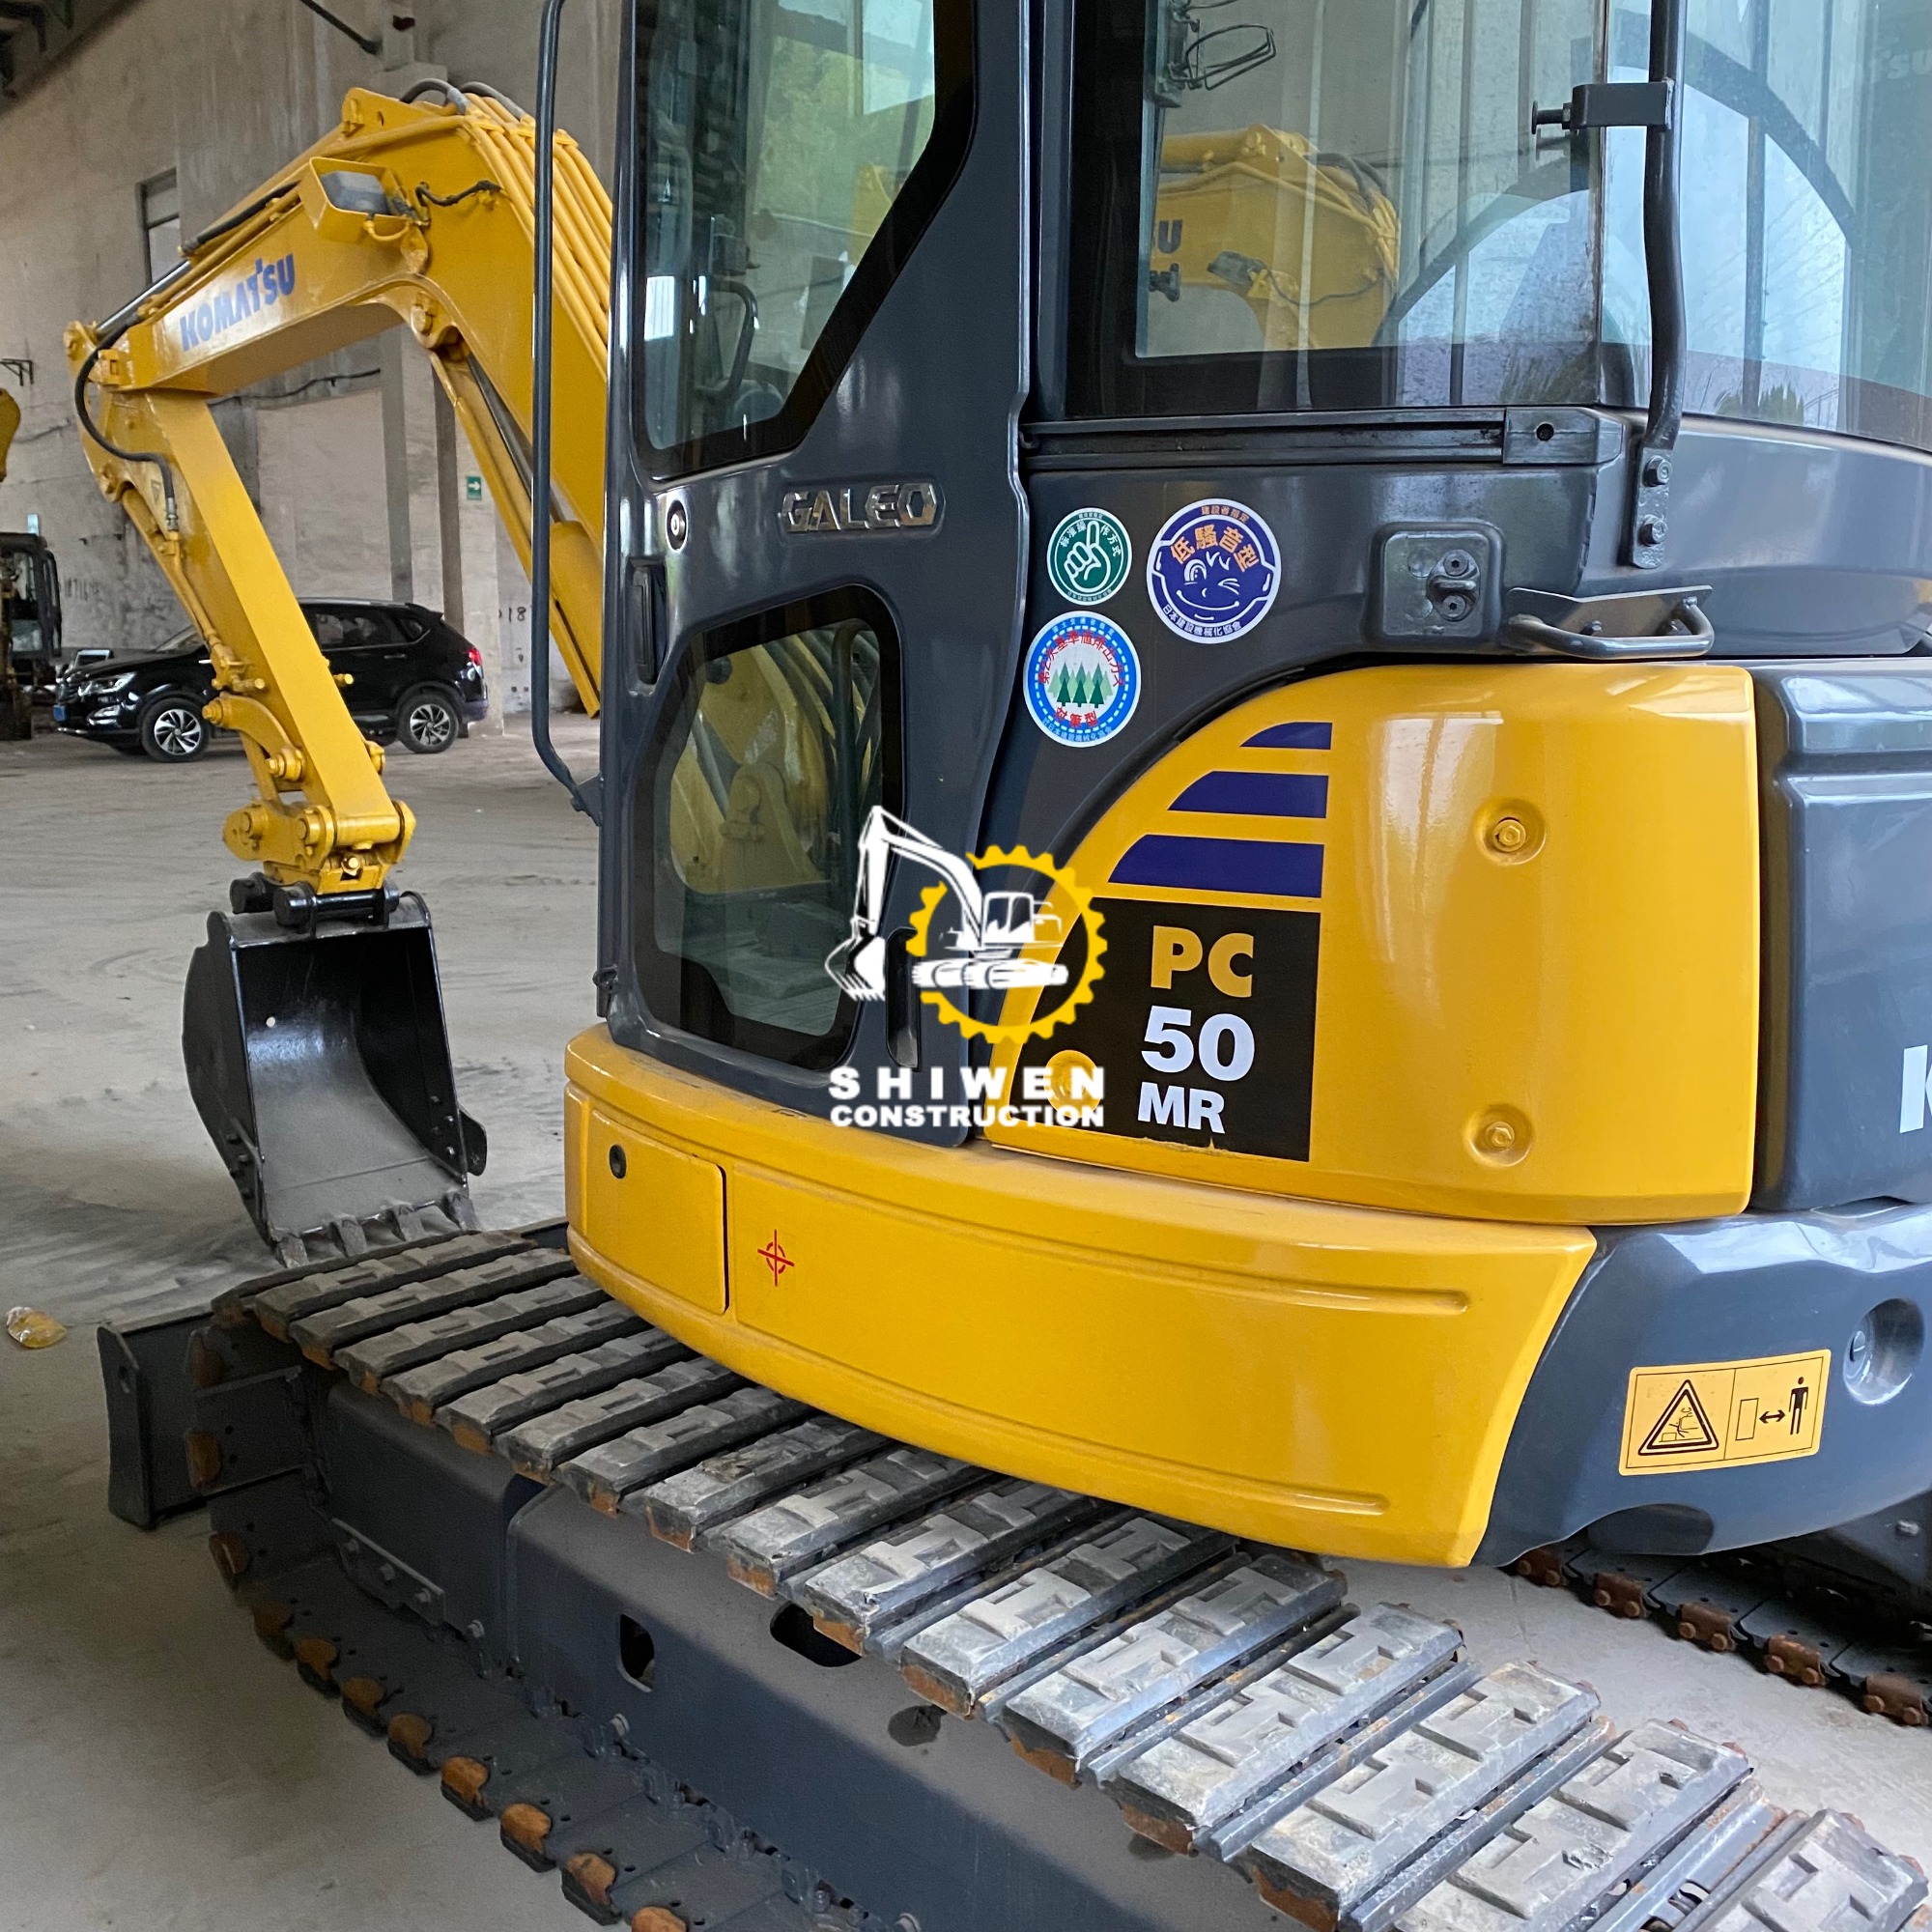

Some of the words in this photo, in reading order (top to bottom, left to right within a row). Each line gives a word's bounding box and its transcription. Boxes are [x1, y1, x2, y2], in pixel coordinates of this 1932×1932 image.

[180, 253, 296, 352] KOMATSU
[781, 481, 938, 532] GALEO
[1151, 924, 1254, 998] PC
[1141, 1005, 1255, 1082] 50
[1138, 1081, 1226, 1134] MR
